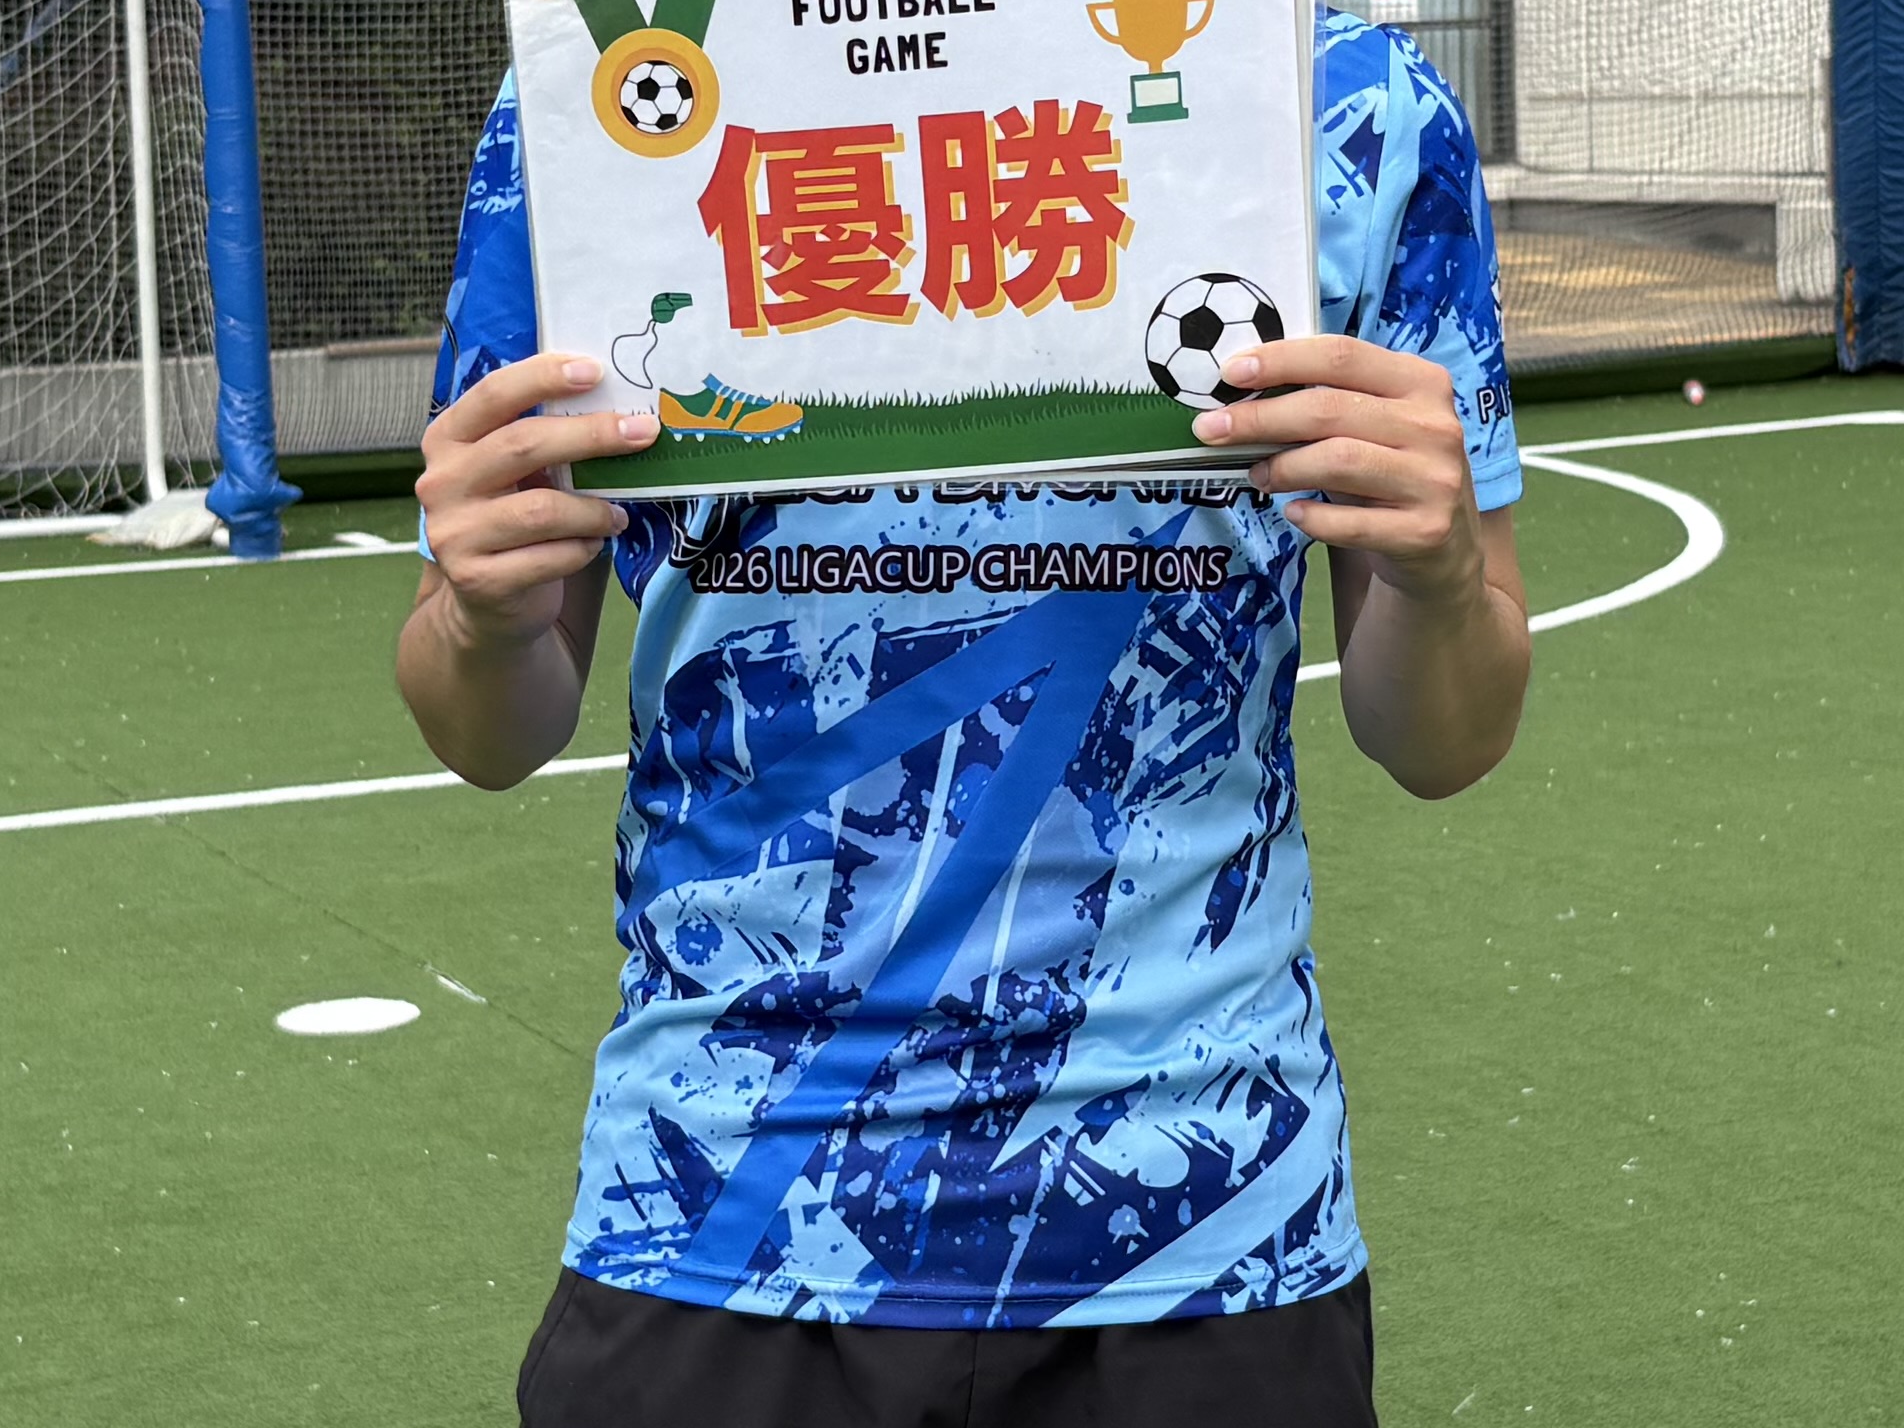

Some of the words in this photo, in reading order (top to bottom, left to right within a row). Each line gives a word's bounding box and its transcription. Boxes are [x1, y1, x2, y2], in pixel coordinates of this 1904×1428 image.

[846, 31, 949, 75] GAME
[696, 99, 1138, 337] 優勝
[693, 549, 771, 590] 2026
[780, 548, 966, 588] LIGACUP
[976, 547, 1227, 587] CHAMPIONS
